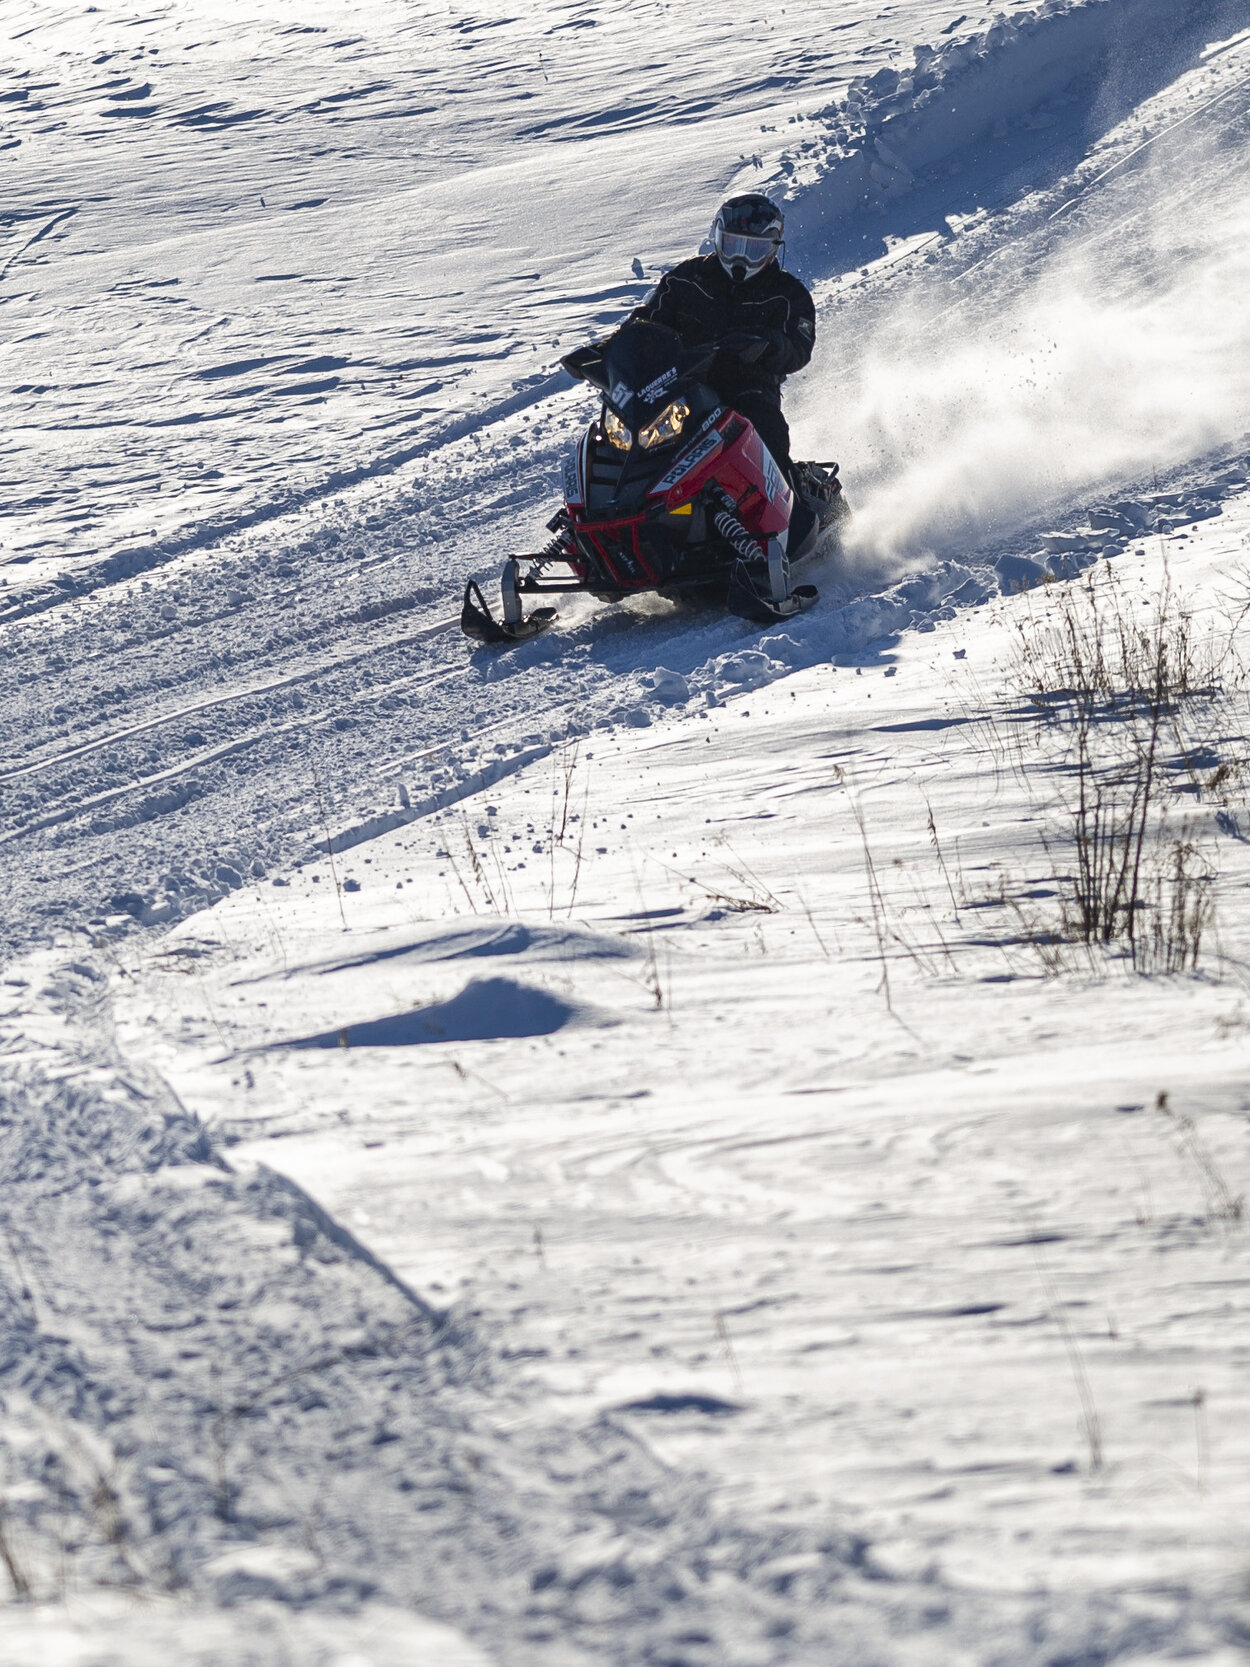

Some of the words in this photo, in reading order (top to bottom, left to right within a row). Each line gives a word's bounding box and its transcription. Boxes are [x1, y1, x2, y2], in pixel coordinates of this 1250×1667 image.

[701, 407, 722, 431] 800
[564, 457, 578, 497] POLARIS
[662, 438, 717, 484] POLARIS
